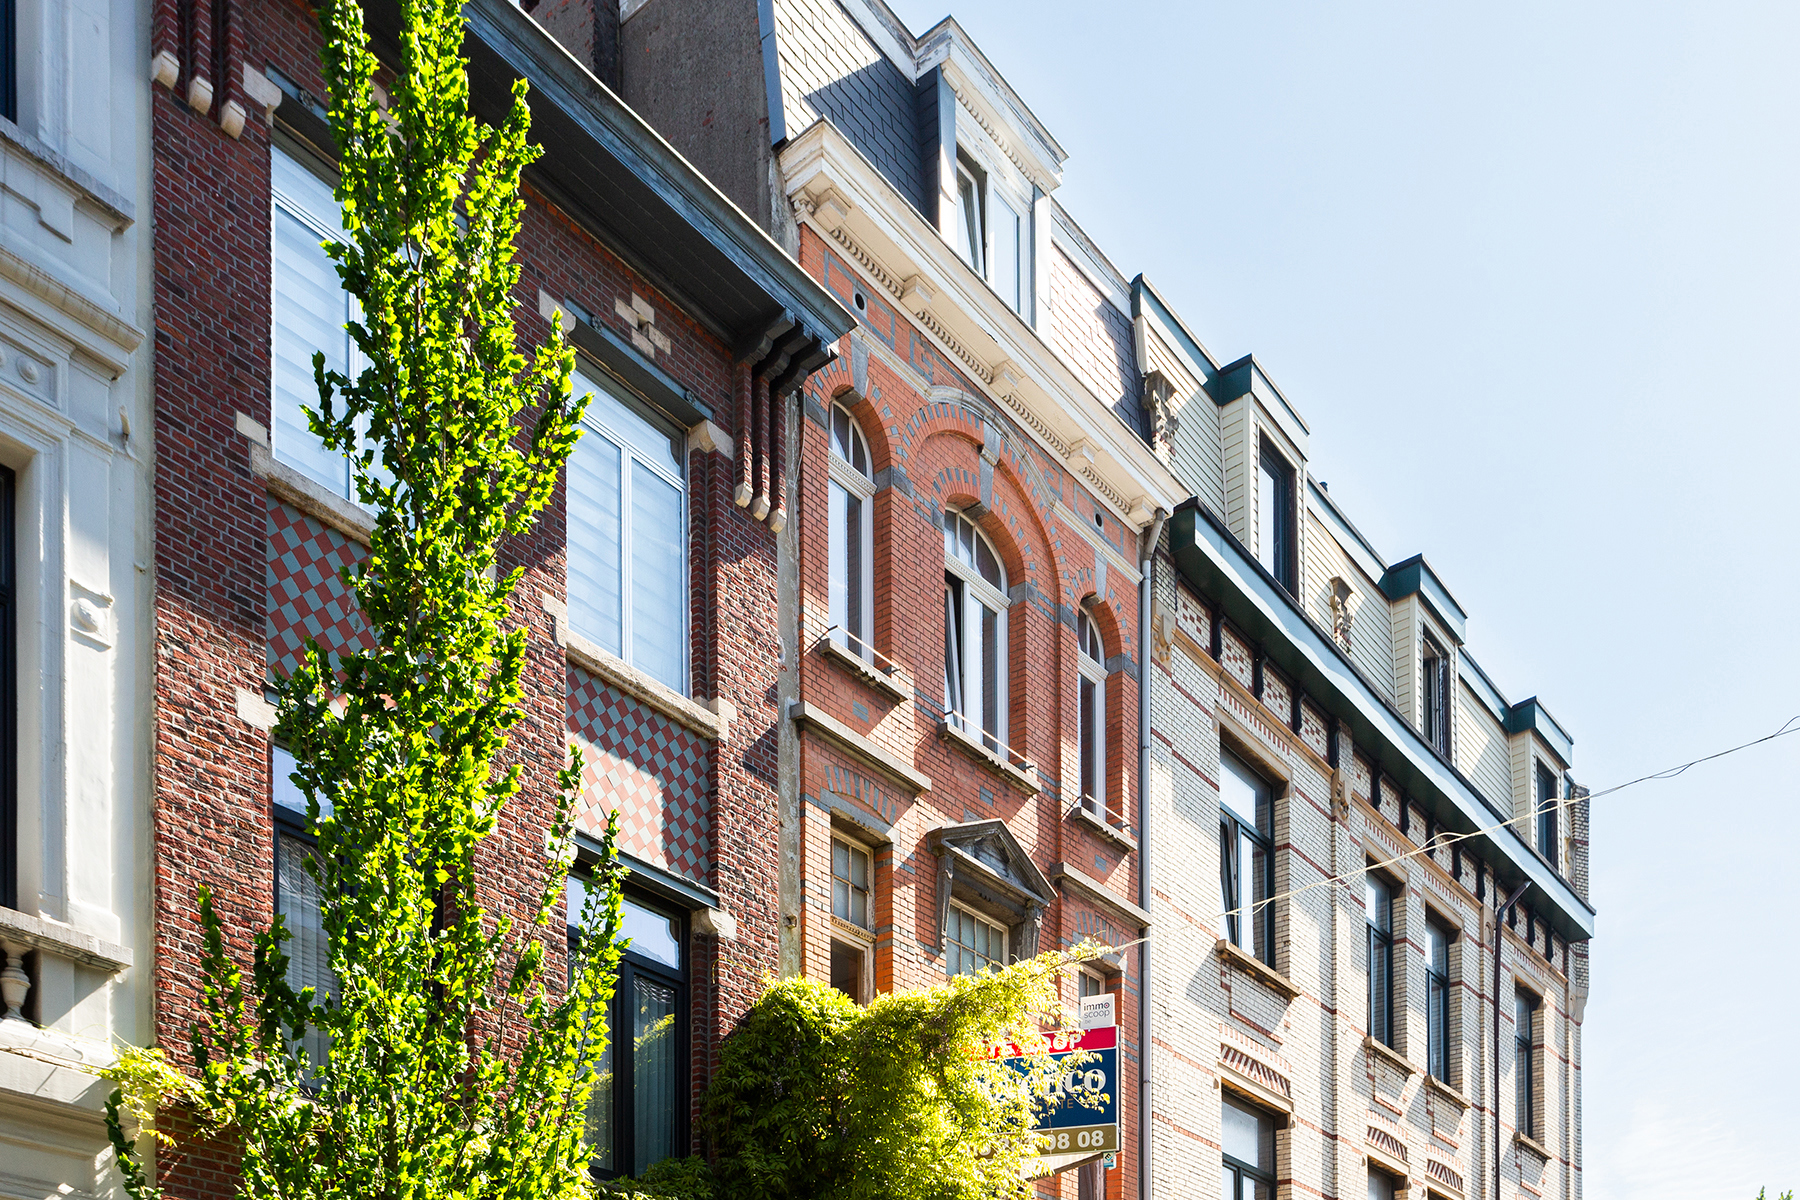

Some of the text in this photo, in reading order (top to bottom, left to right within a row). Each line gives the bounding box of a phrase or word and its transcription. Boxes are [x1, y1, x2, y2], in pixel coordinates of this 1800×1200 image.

[1083, 1002, 1110, 1011] immo
[1083, 1009, 1110, 1018] scoop
[1043, 1132, 1070, 1151] 08
[1077, 1129, 1104, 1148] 08
